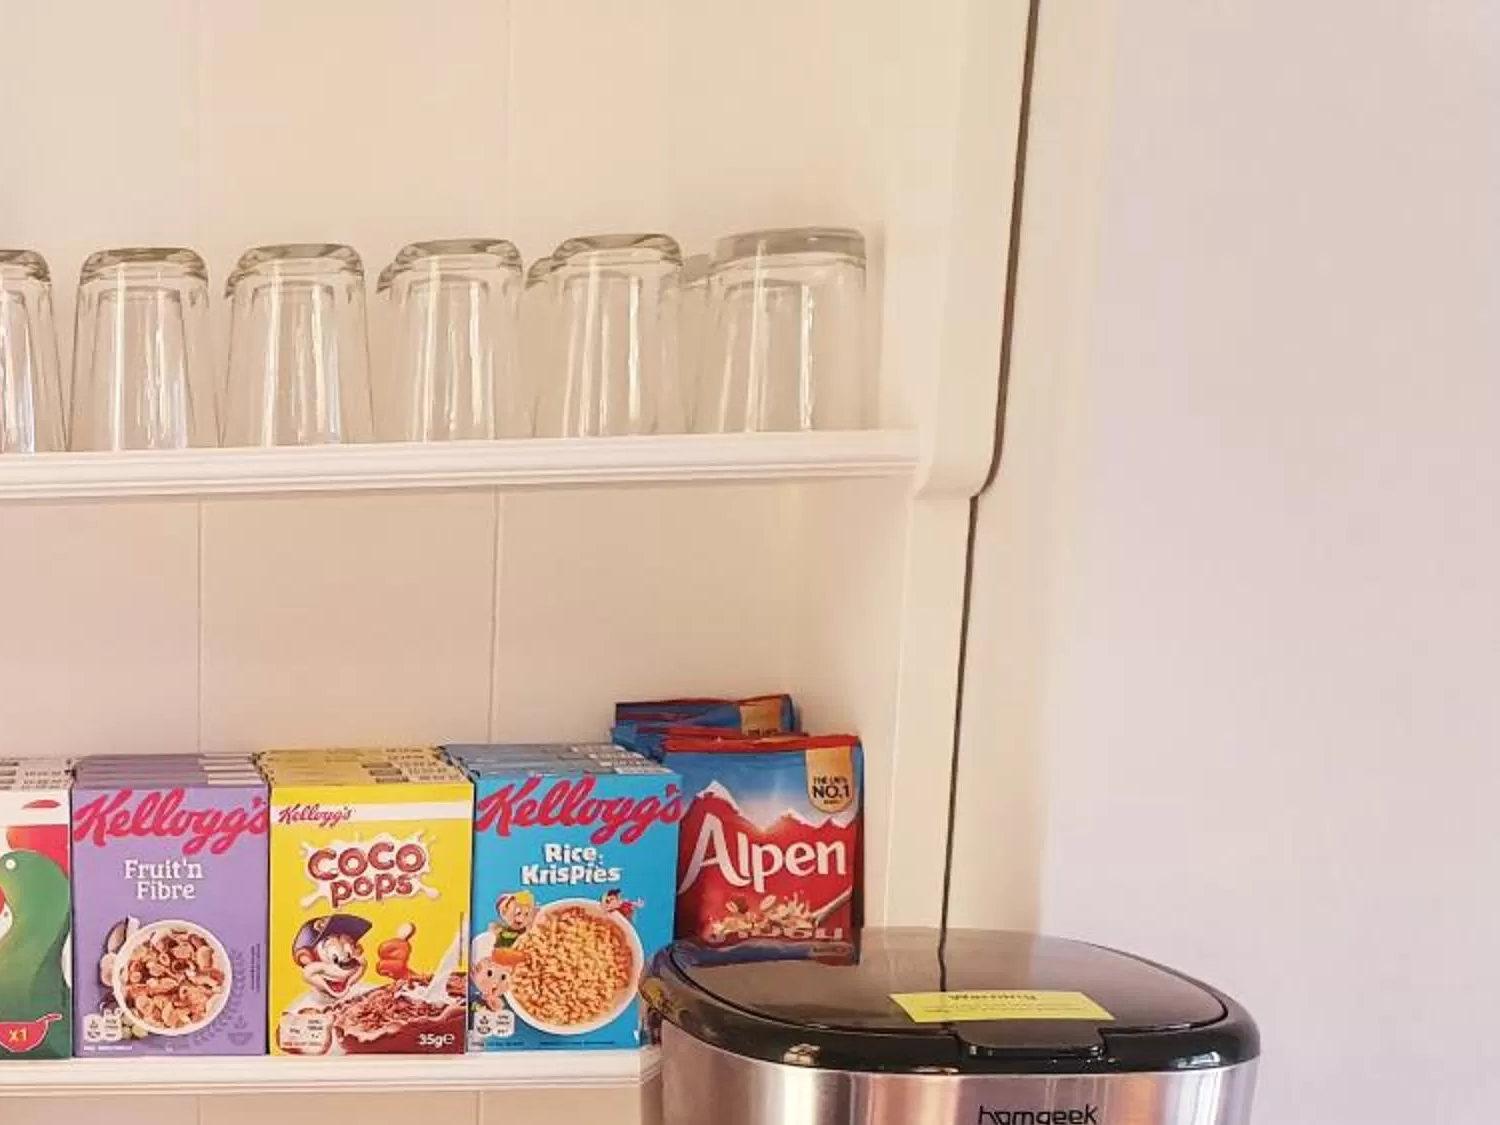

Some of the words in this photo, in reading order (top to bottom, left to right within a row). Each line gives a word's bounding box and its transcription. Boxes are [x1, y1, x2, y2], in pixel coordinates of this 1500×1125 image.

[74, 787, 269, 856] Kellogg's
[278, 804, 353, 828] Kellogg's
[475, 773, 684, 844] Kellogg's
[124, 858, 204, 880] Fruit'n
[307, 842, 426, 880] COCO
[544, 843, 598, 864] Rice
[678, 813, 847, 893] Alpen
[136, 880, 196, 901] Fibre
[330, 872, 413, 908] pops
